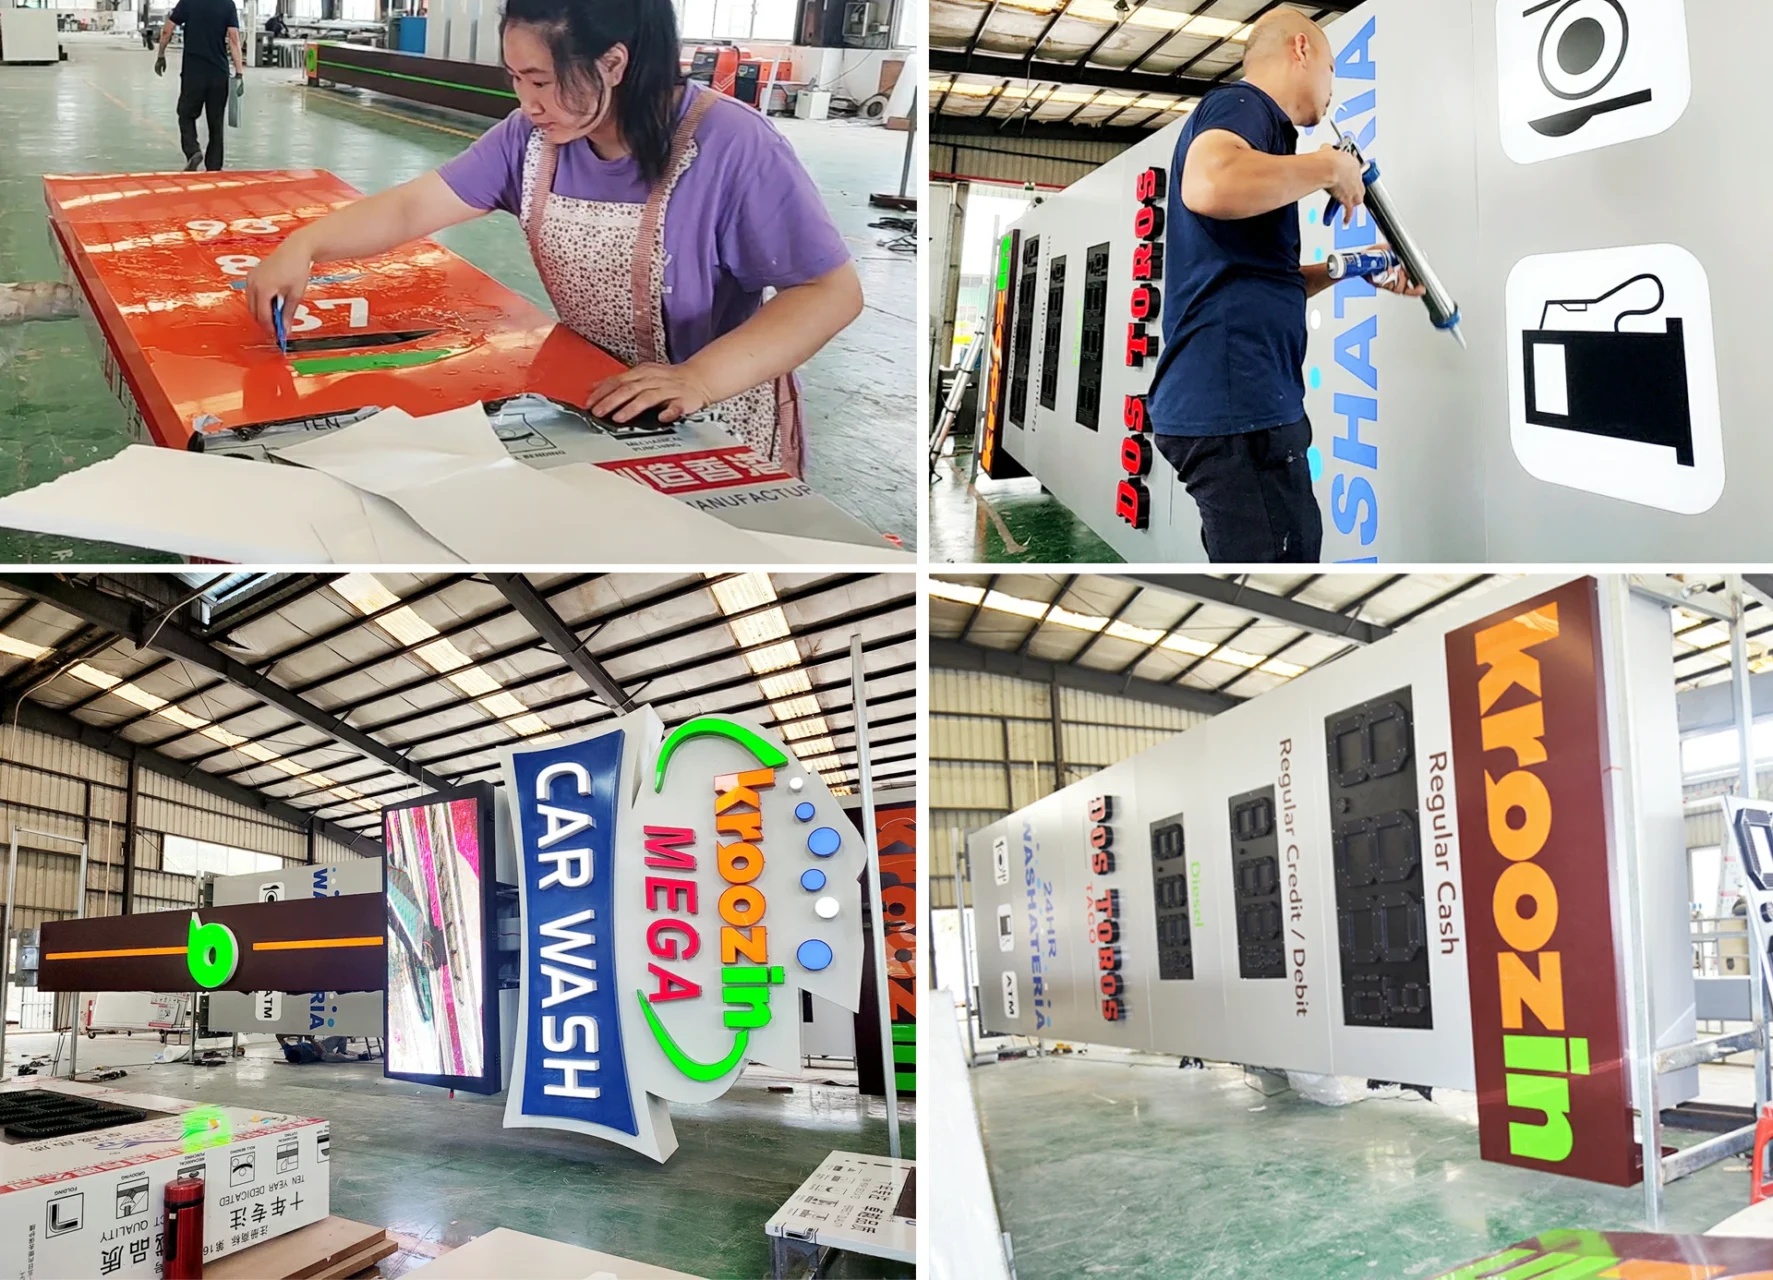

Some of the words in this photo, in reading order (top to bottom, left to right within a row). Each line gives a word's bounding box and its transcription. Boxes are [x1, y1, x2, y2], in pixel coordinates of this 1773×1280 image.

[1125, 165, 1166, 368] TOROS
[1115, 394, 1153, 529] DOS
[1278, 738, 1297, 837] Regular
[1426, 751, 1453, 872] Regular
[536, 762, 595, 890] CAR
[1088, 795, 1114, 875] DOS
[643, 825, 702, 1003] MEGA
[714, 767, 784, 1028] kroozin
[1085, 881, 1096, 945] TACO
[1190, 861, 1204, 928] Diesel
[1286, 844, 1304, 923] Credit
[1437, 881, 1460, 955] Cash
[1474, 601, 1590, 1162] kroozin
[1095, 888, 1124, 1021] TOROS
[1293, 948, 1309, 1018] Debit
[539, 909, 600, 1100] WASH
[1005, 974, 1015, 1016] ATM
[54, 1186, 78, 1196] FOLDING
[120, 1170, 146, 1180] GROOVING
[219, 1185, 265, 1207] DEDICATED
[230, 1191, 304, 1230] 十年专注
[269, 1180, 288, 1191] YEAR
[292, 1175, 304, 1184] TEN
[100, 1219, 149, 1243] QUALITY
